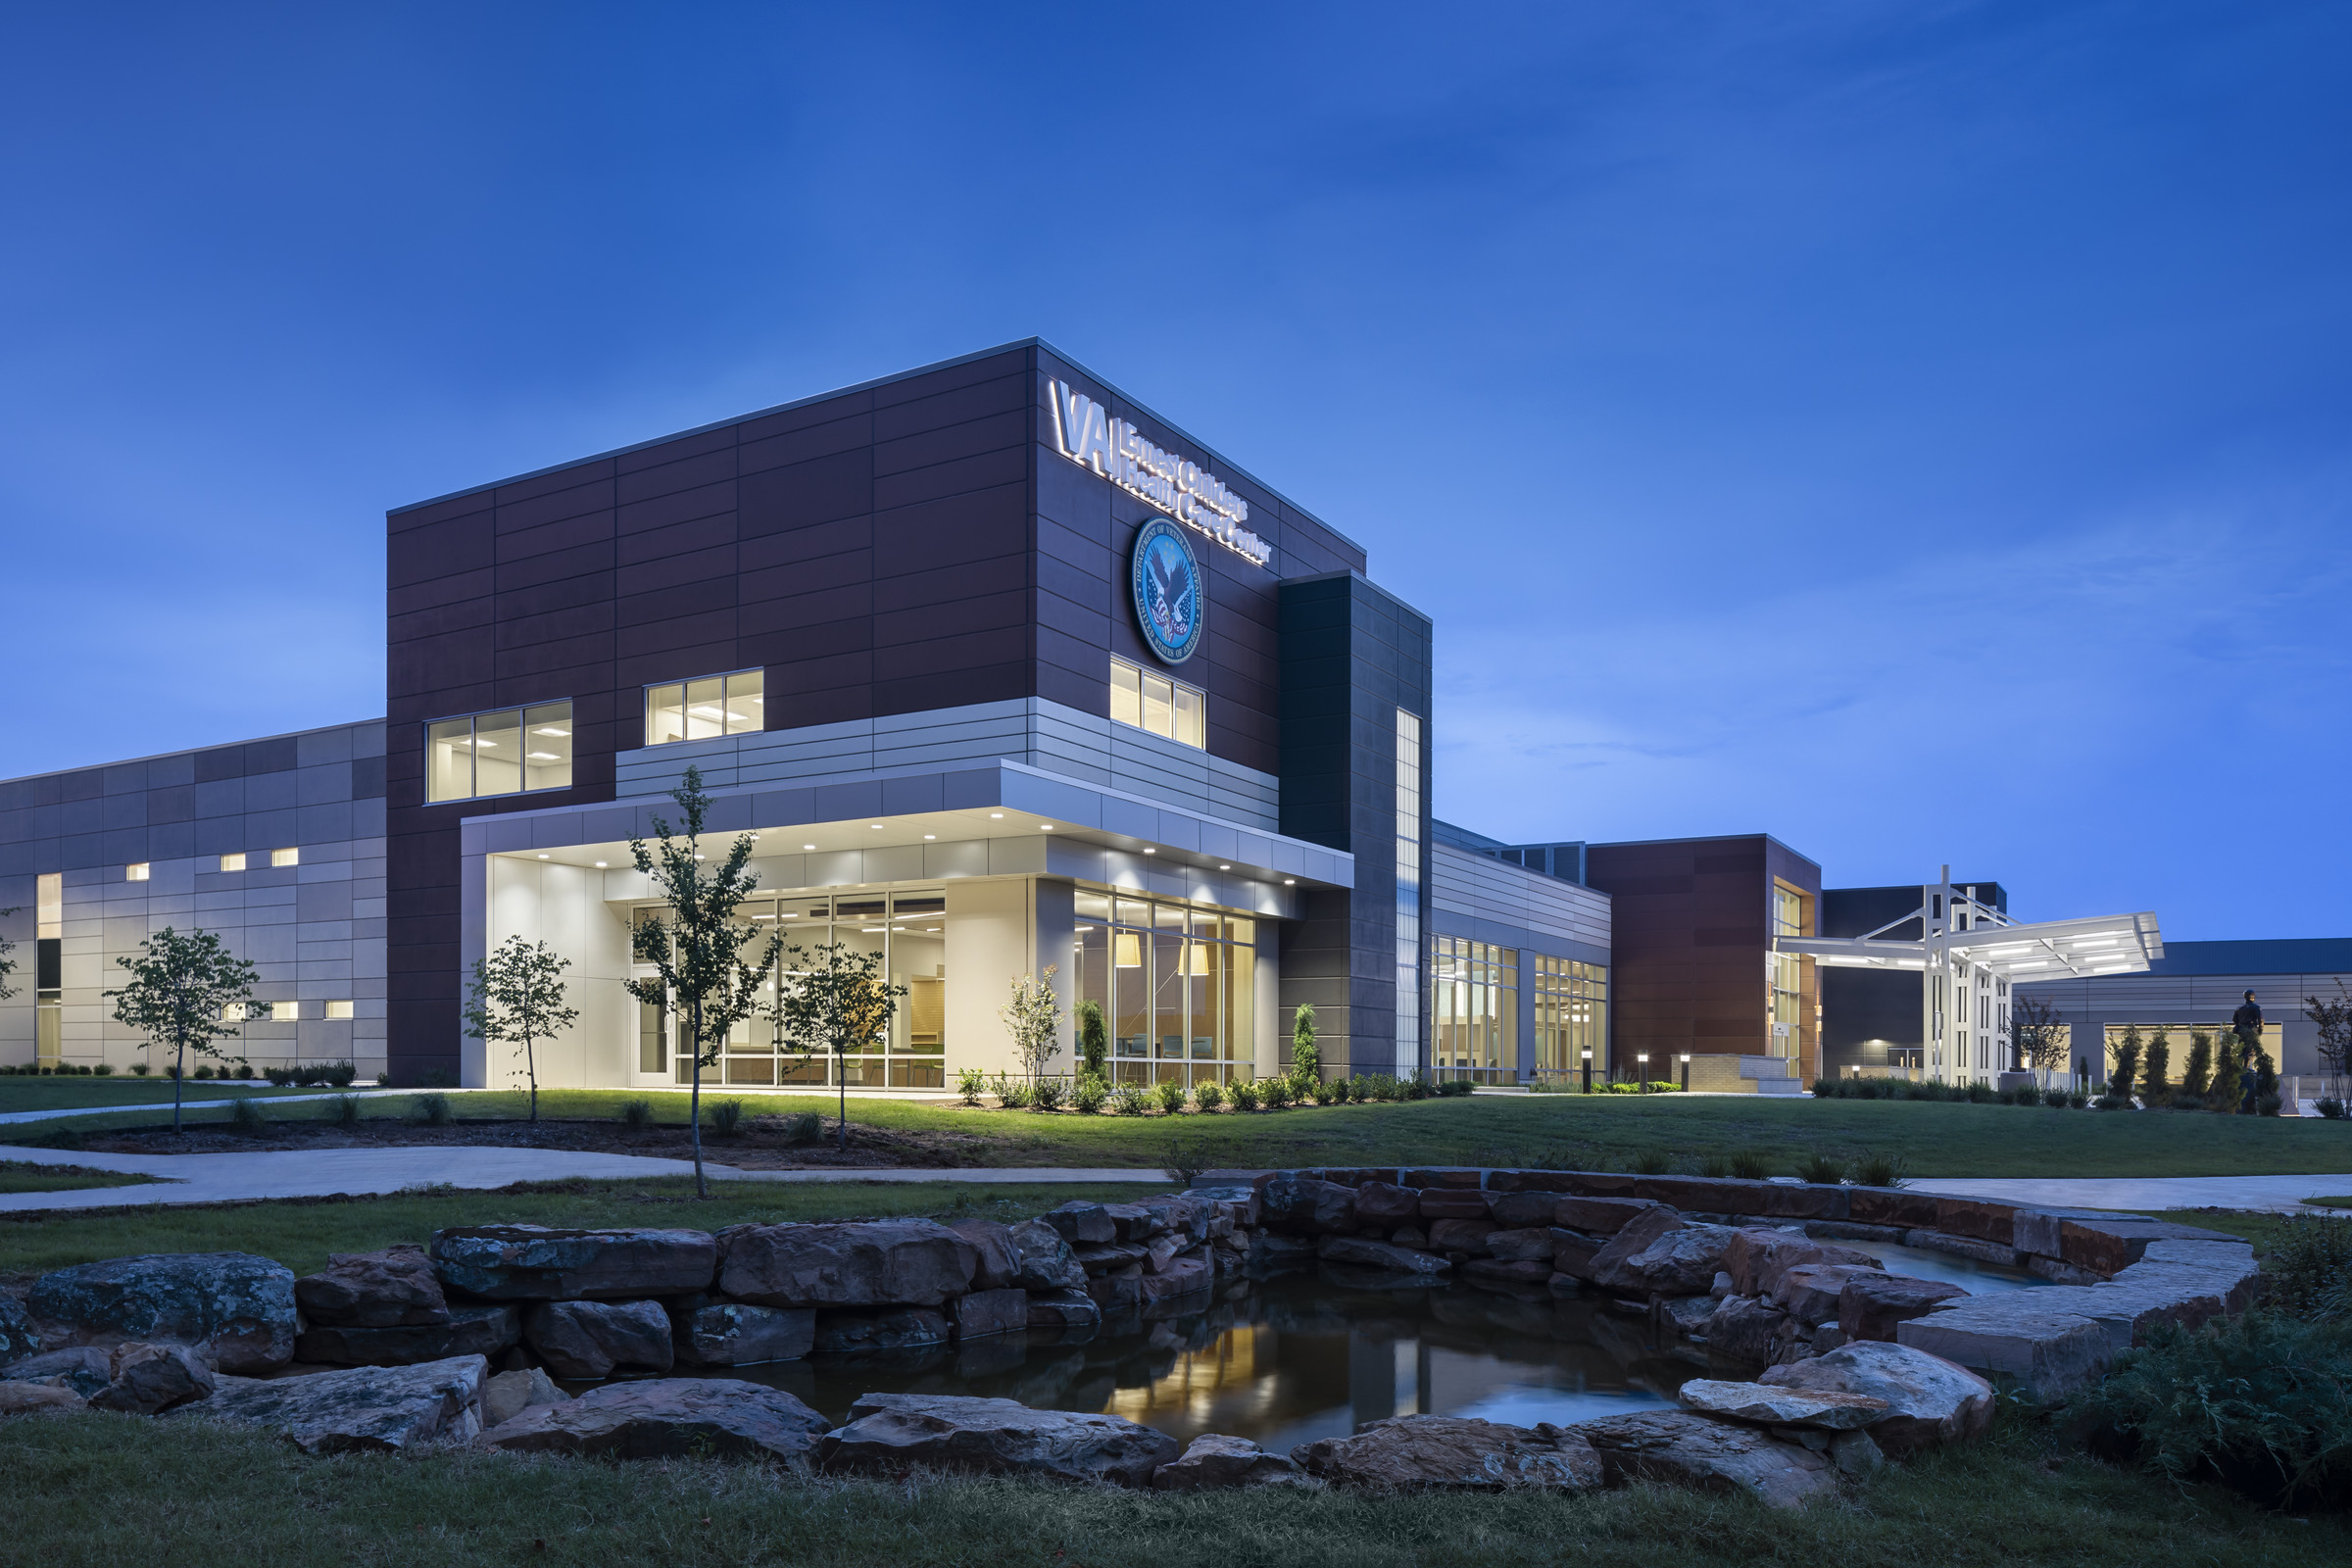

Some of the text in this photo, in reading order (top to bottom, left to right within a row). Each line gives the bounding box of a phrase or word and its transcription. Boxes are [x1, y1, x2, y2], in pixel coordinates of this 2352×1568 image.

[1054, 380, 1112, 475] VA
[1121, 422, 1248, 520] Ernest Childers
[1120, 456, 1271, 563] Health Care Center
[1137, 525, 1200, 610] DEPARTMENT OF VETERANS AFFAIRS
[1139, 598, 1200, 658] UNITED STATES OF AMERICA
